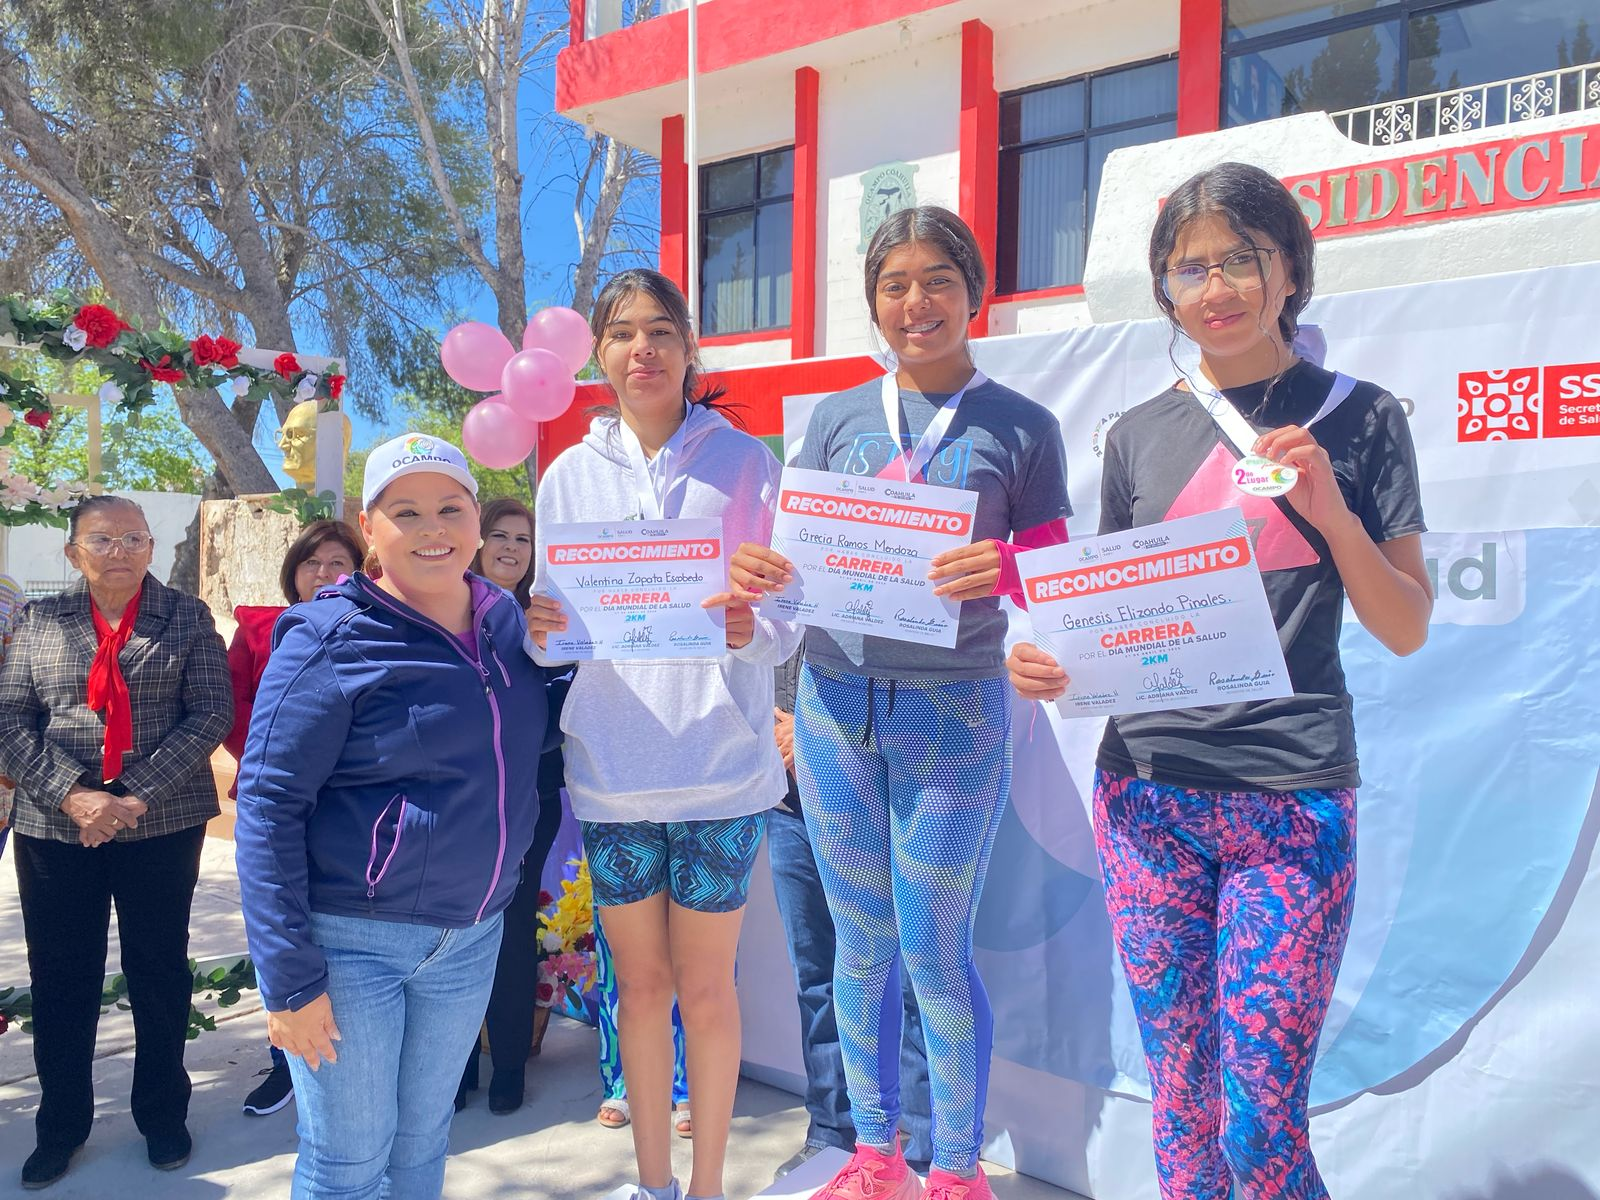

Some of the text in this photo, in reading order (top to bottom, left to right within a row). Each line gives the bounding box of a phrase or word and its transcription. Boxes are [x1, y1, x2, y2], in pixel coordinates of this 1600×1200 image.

[1290, 132, 1600, 232] SIDENCI
[1559, 403, 1600, 414] Secret
[1559, 414, 1600, 425] de Sal
[786, 495, 962, 532] RECONOCIMIENTO
[799, 528, 833, 544] Grecia
[837, 534, 868, 550] Ramos
[554, 543, 713, 562] RECONOCIMIENTO
[803, 563, 818, 572] POR
[819, 565, 826, 573] EL
[842, 569, 876, 580] MUNDIAL
[900, 577, 925, 587] SALUD
[825, 554, 904, 576] CARRERA
[1035, 545, 1240, 599] RECONOCIMIENTO
[576, 574, 623, 588] Valentina
[627, 572, 663, 586] Zapata
[850, 582, 874, 592] 2KM
[599, 592, 671, 606] CARRERA
[625, 614, 646, 622] 2KM
[1063, 611, 1113, 630] Genesis
[1117, 602, 1175, 622] Elizondo
[1100, 621, 1196, 648] CARRERA
[1079, 652, 1096, 661] POR
[1097, 650, 1107, 658] EL
[1125, 641, 1167, 653] MUNDIAL
[1168, 639, 1180, 647] DE
[1183, 636, 1194, 645] LA
[1195, 631, 1227, 643] SALUD
[1141, 653, 1169, 666] 2KM
[1217, 682, 1253, 691] ROSALINDA
